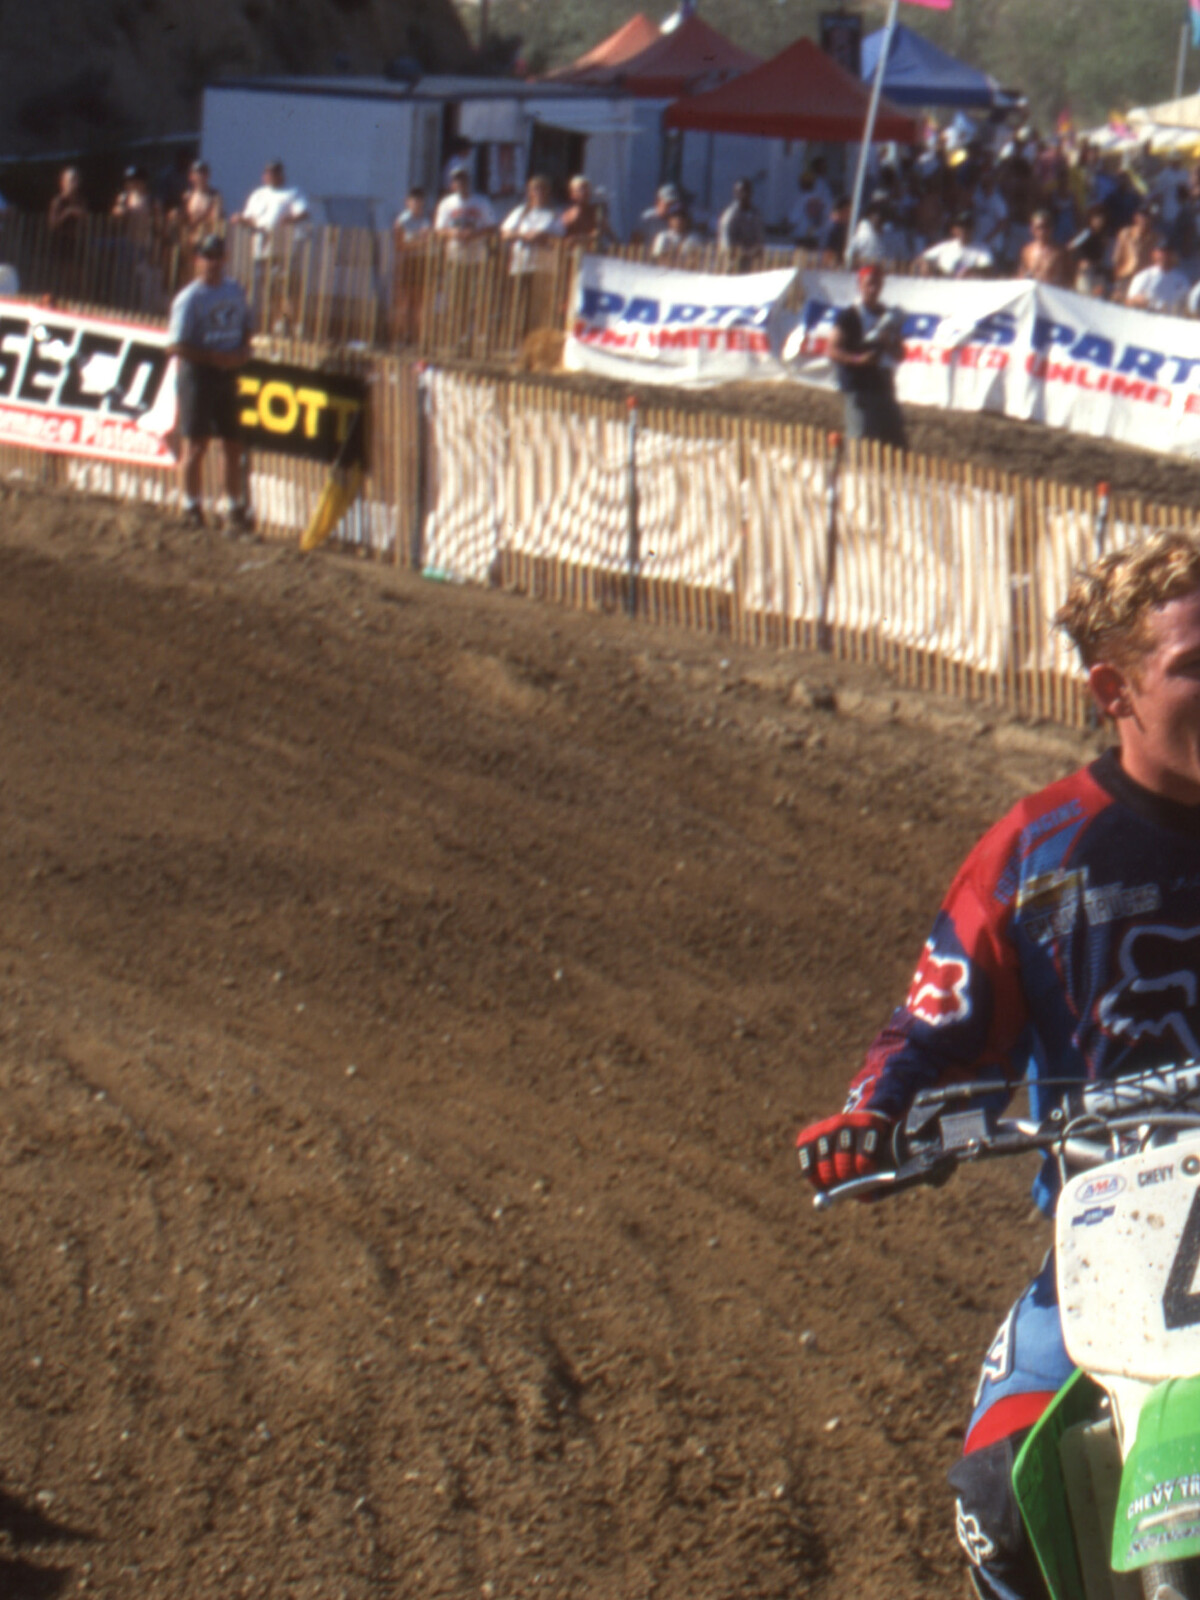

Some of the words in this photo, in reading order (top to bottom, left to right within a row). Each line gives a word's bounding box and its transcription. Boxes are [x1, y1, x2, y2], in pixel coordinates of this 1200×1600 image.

[1084, 1175, 1119, 1196] AMA
[1137, 1164, 1175, 1188] CHEVY
[1127, 1486, 1175, 1521] CHEVY
